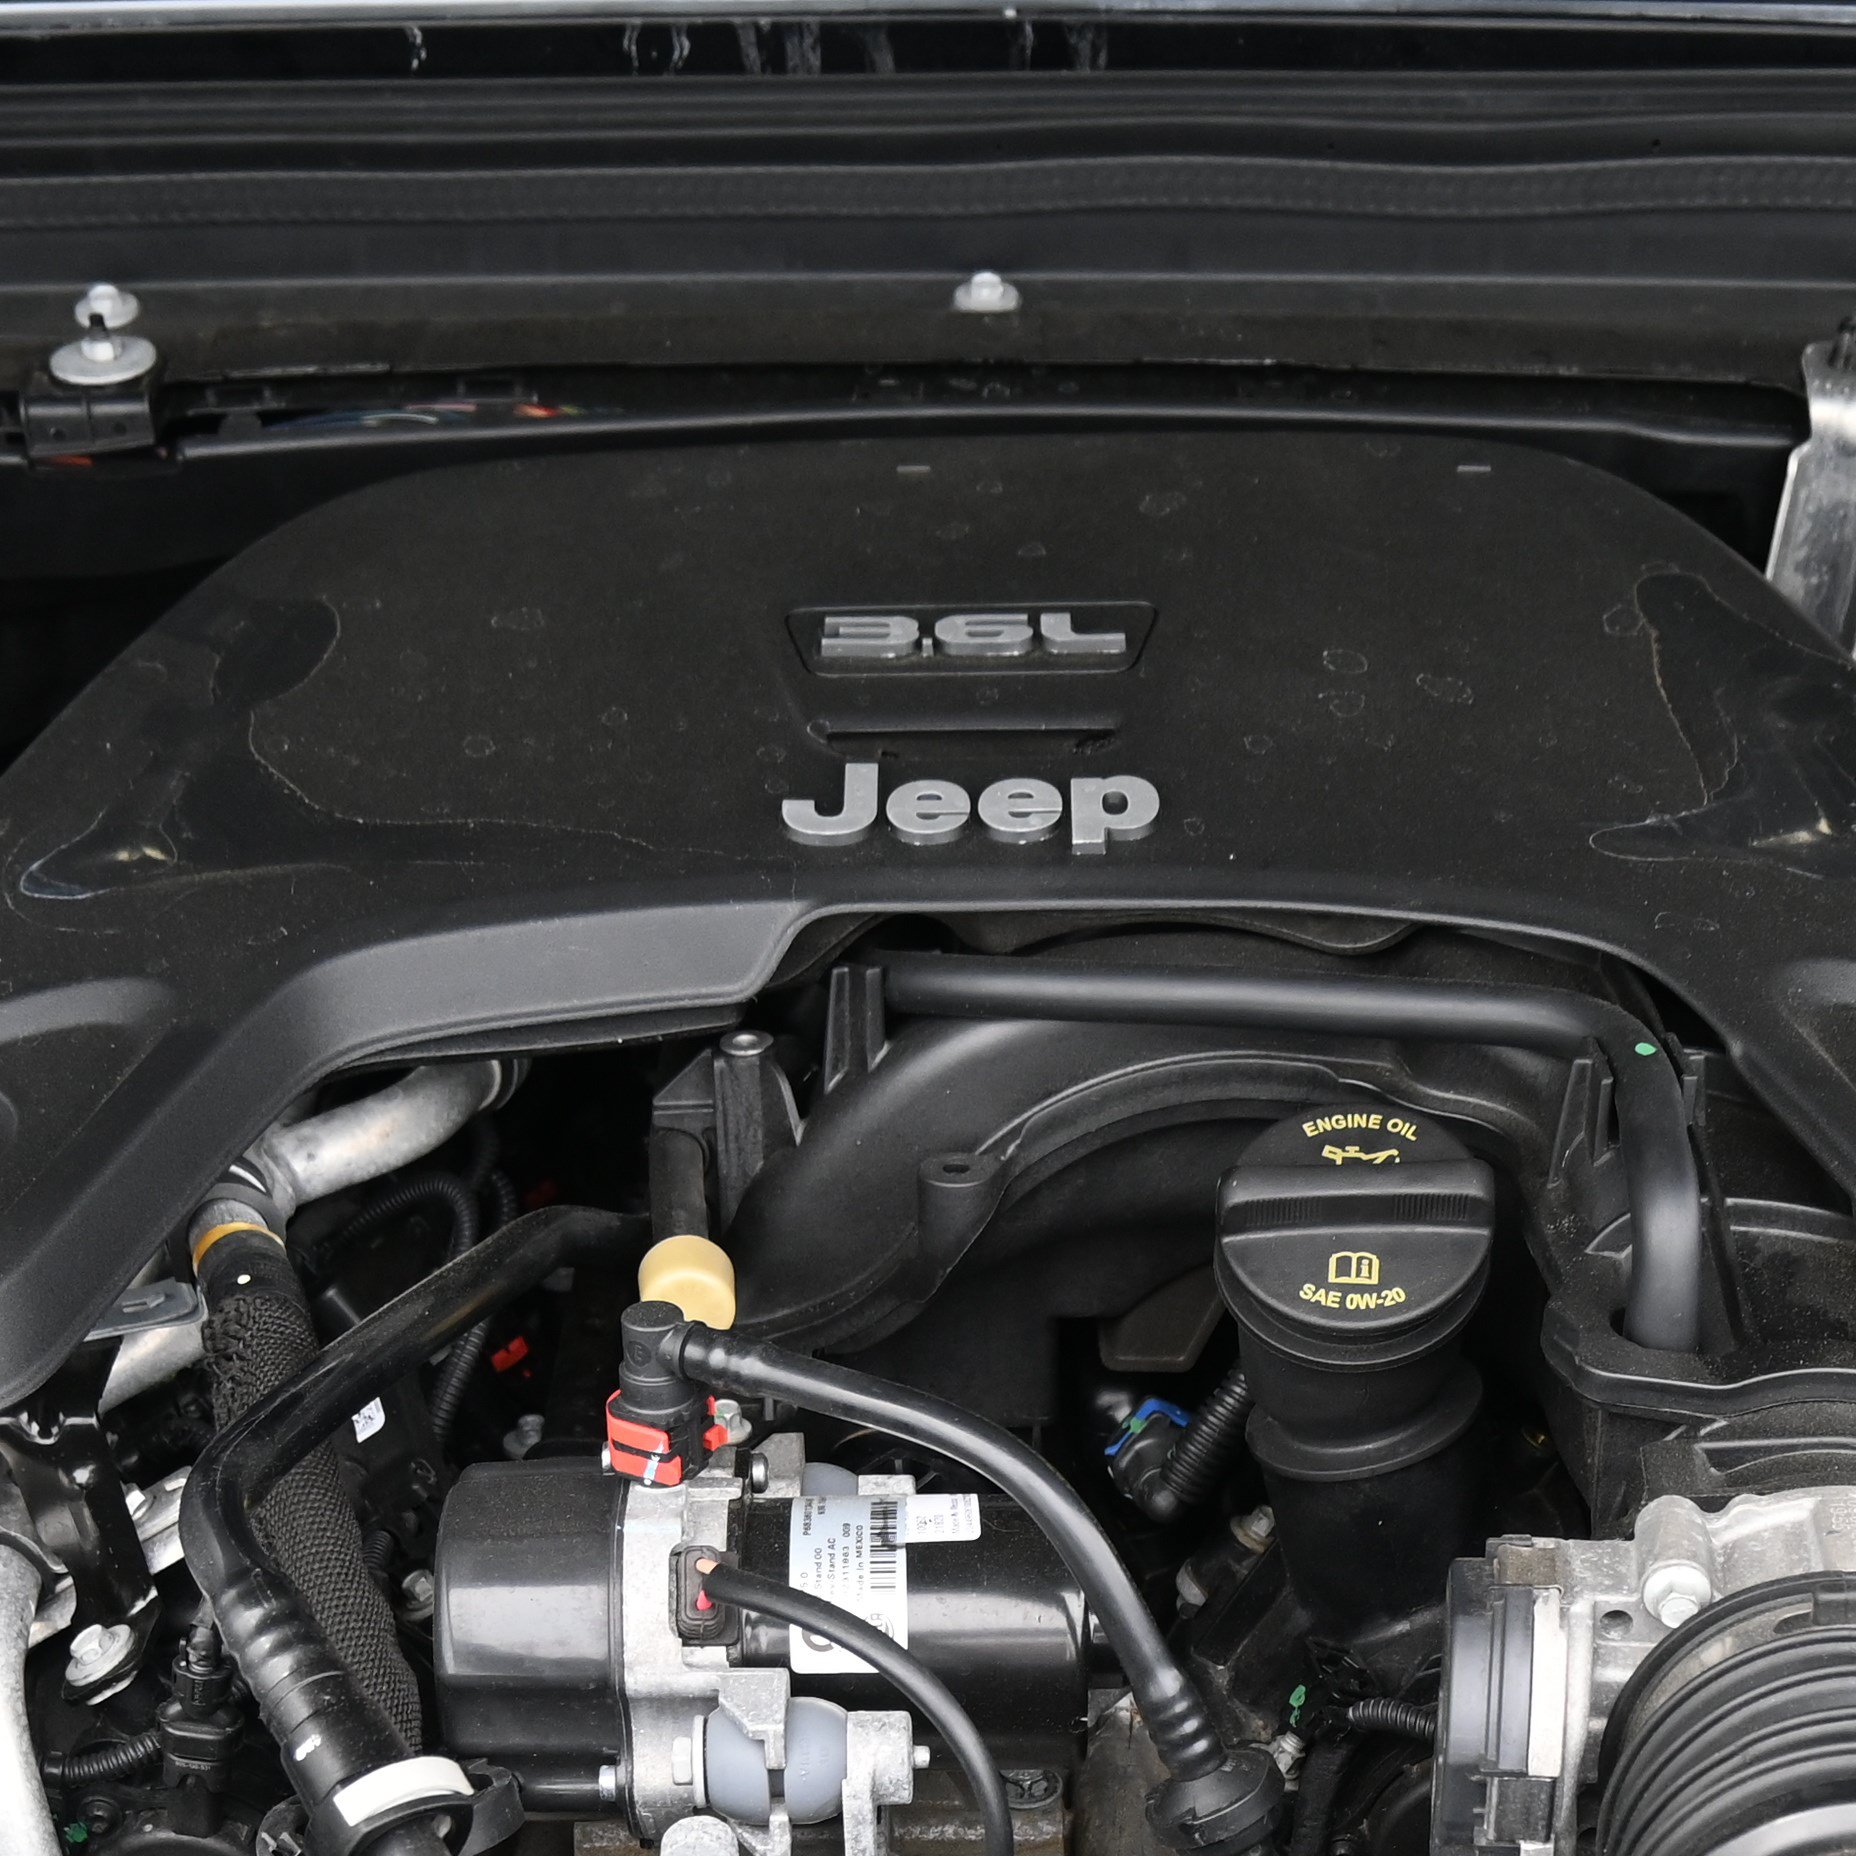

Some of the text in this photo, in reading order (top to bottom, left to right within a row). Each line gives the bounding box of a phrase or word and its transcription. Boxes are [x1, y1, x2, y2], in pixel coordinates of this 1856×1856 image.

[821, 612, 1126, 658] 3.6L
[781, 762, 1161, 856] Jeep
[1302, 1113, 1419, 1142] ENGINE OIL
[1299, 1283, 1407, 1310] SAE 0W-20
